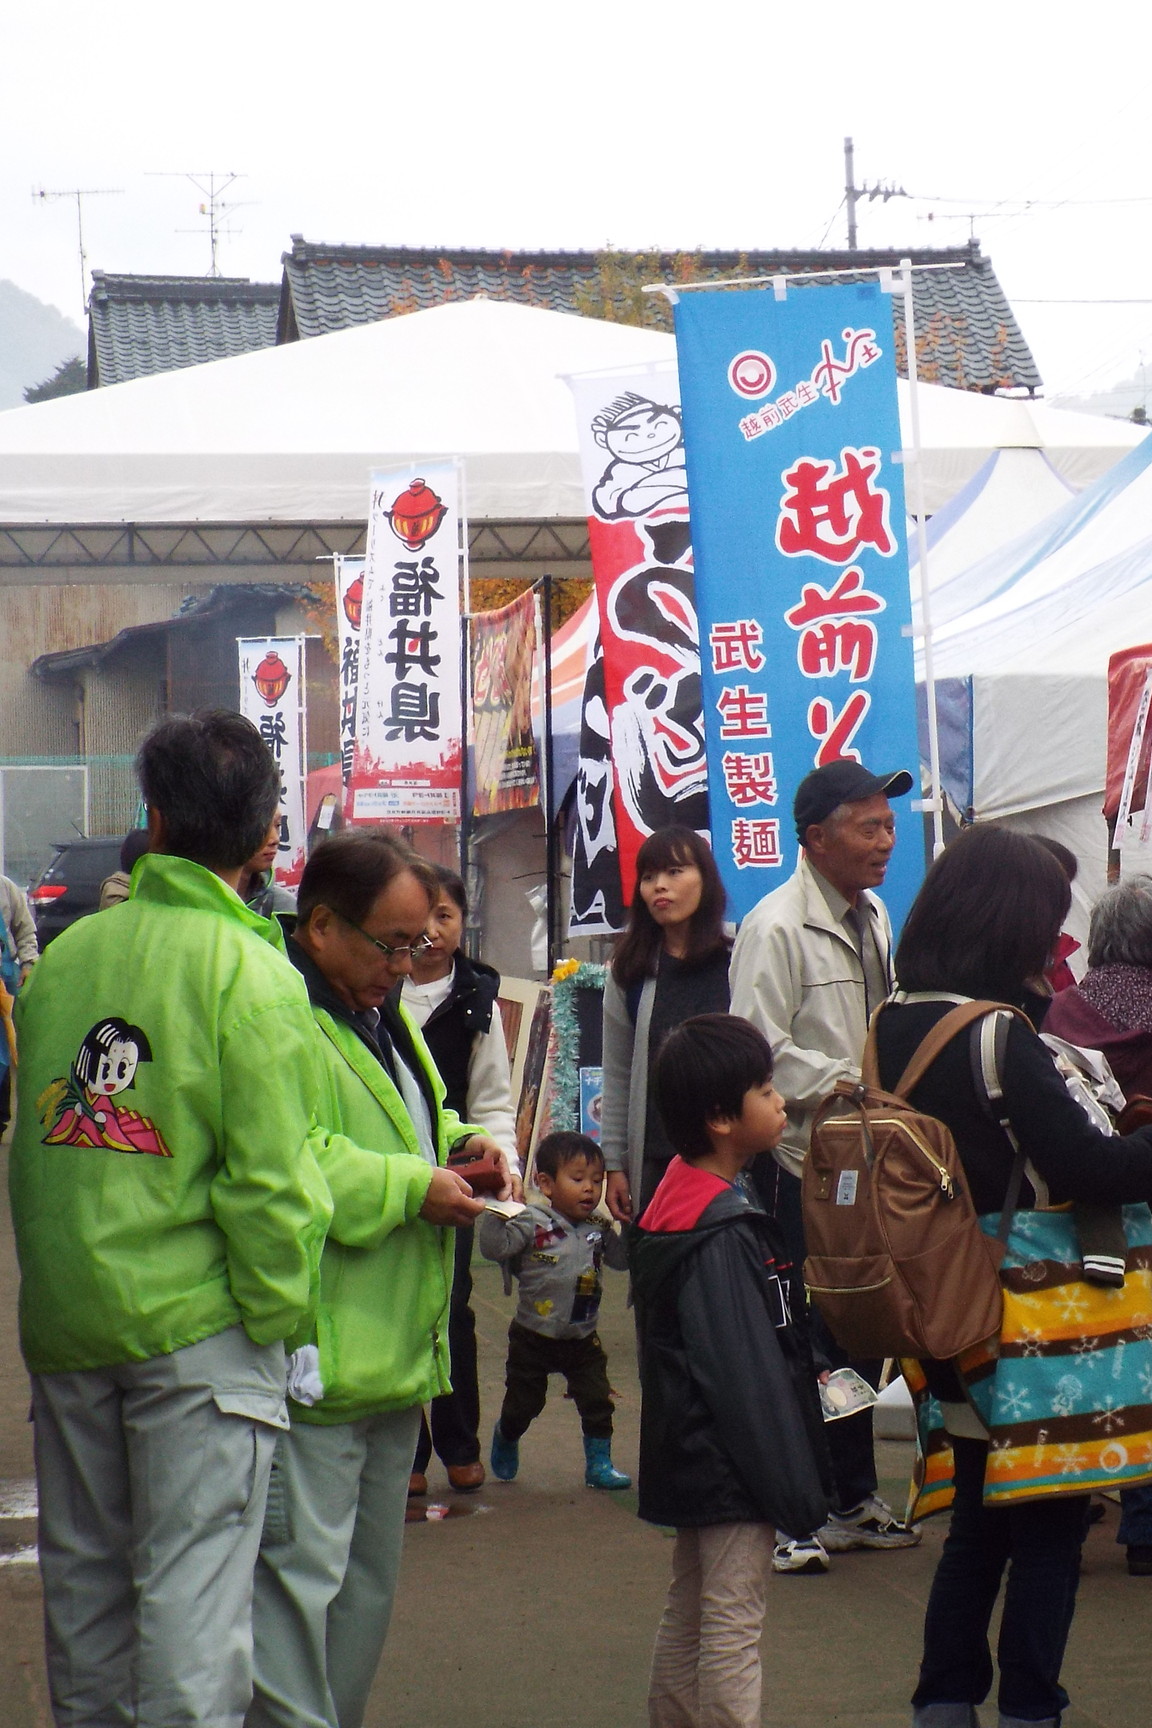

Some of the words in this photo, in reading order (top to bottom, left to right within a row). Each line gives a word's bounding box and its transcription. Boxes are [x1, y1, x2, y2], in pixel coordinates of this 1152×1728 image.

[739, 383, 817, 441] 越前武生
[711, 620, 782, 870] 武生製麺
